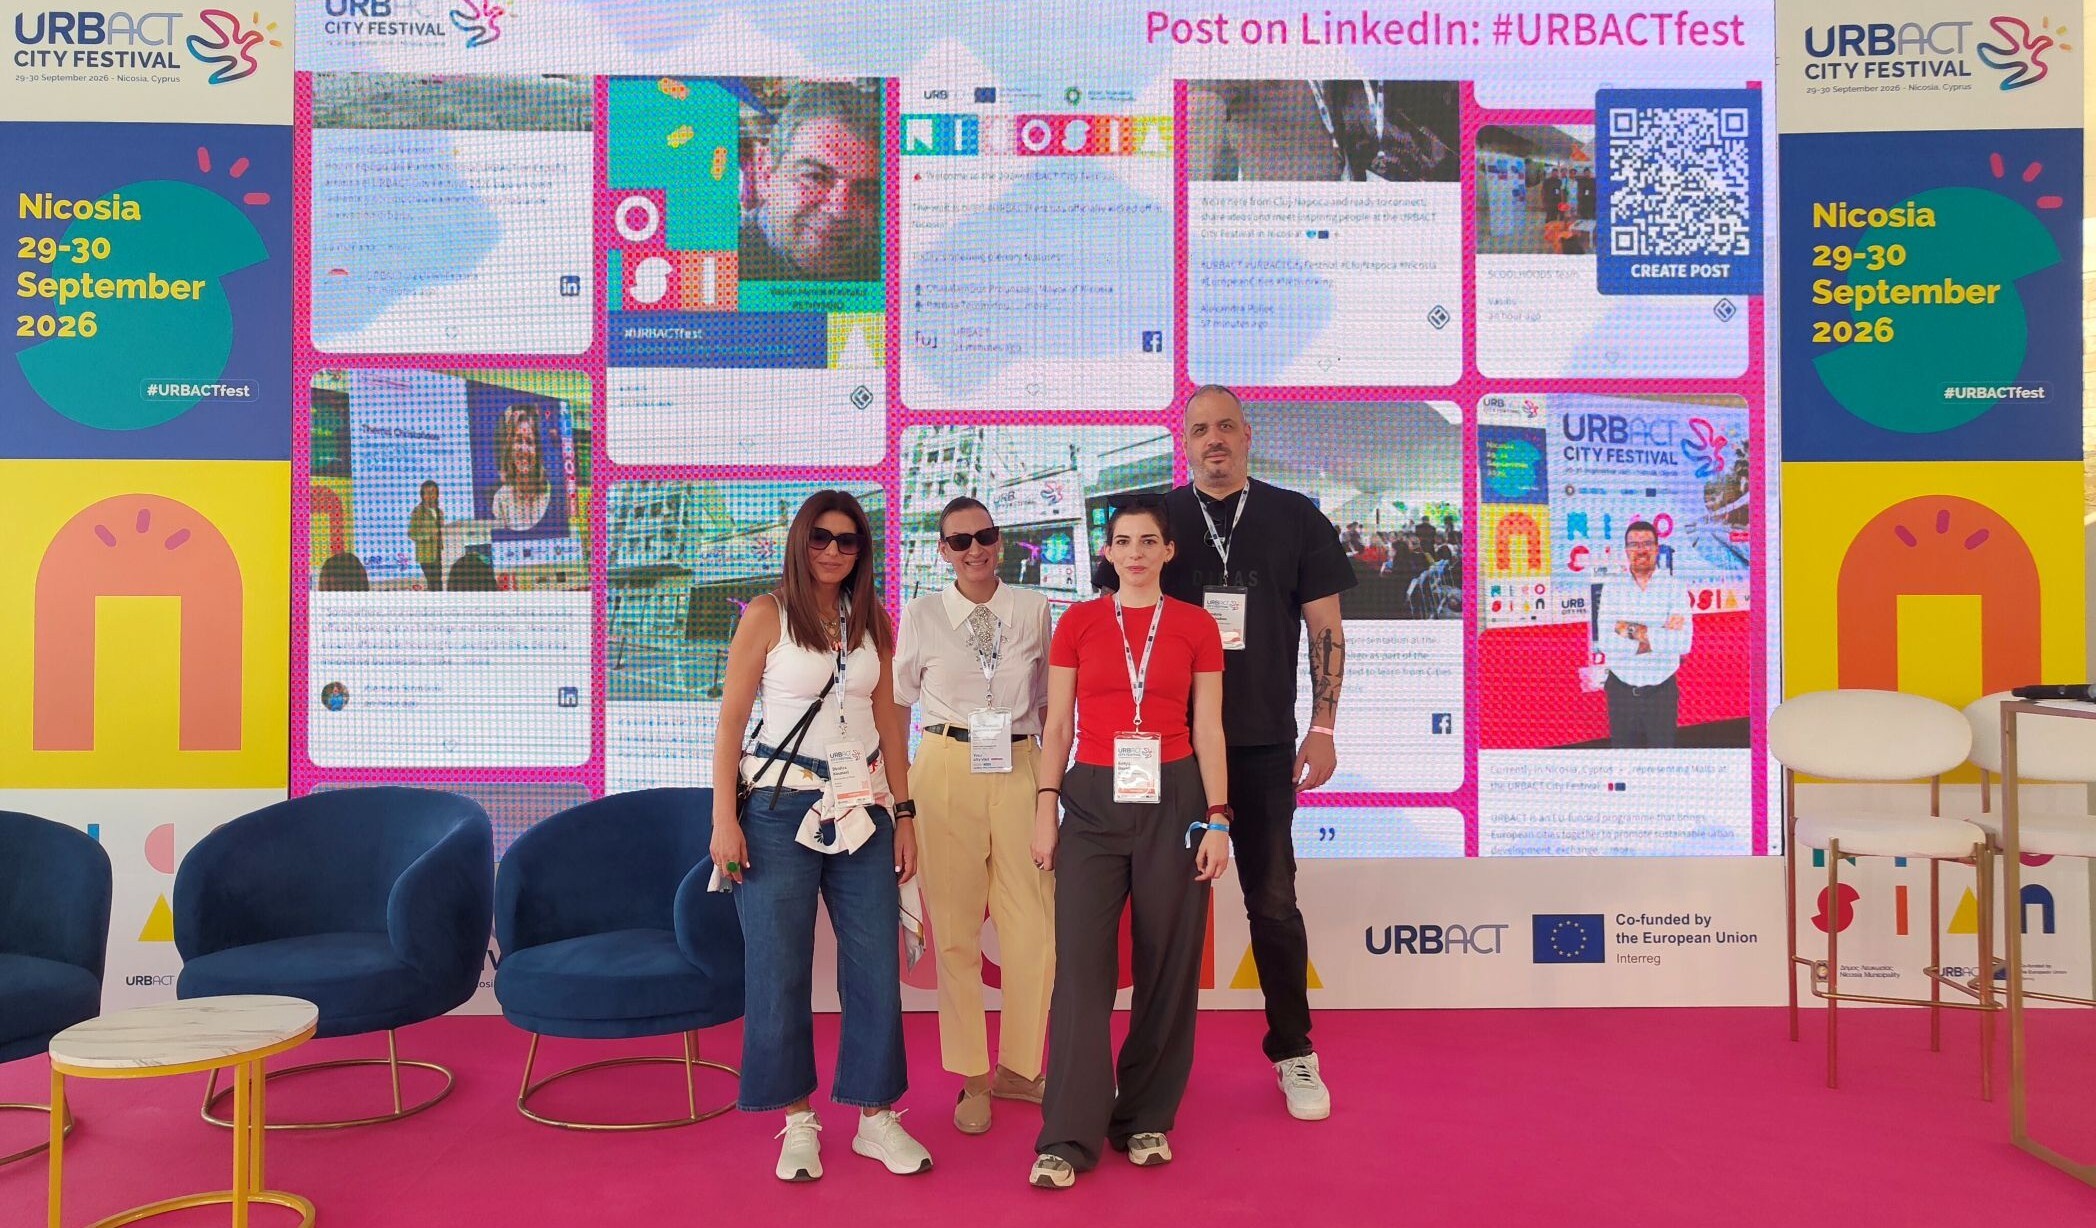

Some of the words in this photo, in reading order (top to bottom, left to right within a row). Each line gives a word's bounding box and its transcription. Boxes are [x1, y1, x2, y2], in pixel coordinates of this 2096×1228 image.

[15, 11, 184, 46] URBACT
[324, 22, 364, 35] CITY
[368, 22, 446, 36] FESTIVAL
[1147, 11, 1228, 46] Post
[1241, 19, 1288, 46] on
[1302, 11, 1481, 47] LinkedIn:
[1492, 11, 1746, 47] #URBACTfest
[1804, 21, 1973, 58] URBACT
[14, 50, 69, 68] CITY
[73, 50, 181, 69] FESTIVAL
[1804, 62, 1859, 80] CITY
[1864, 60, 1972, 79] FESTIVAL
[15, 74, 39, 83] 29-30
[41, 74, 87, 84] September
[151, 76, 181, 84] Cyprus
[1806, 86, 1831, 94] 29-30
[1832, 85, 1878, 94] September
[1880, 84, 1901, 92] 2026
[1942, 83, 1972, 92] Cyprus
[906, 118, 1167, 151] NIOSIA
[17, 192, 142, 221] Nicosia
[1812, 201, 1937, 228] Nicosia
[16, 236, 112, 264] 29-30
[1811, 244, 1907, 271] 29-30
[1631, 264, 1687, 278] CREATE
[1690, 263, 1731, 278] POST
[16, 272, 206, 304] September
[1811, 278, 2001, 312] September
[16, 311, 99, 338] 2026
[1811, 316, 1895, 343] 2026
[146, 383, 250, 399] #URBACTfest
[1943, 386, 2046, 400] #URBACTfest
[1562, 412, 1680, 447] URBACT
[1563, 446, 1606, 462] CITY
[1607, 448, 1679, 466] FESTIVAL
[1561, 598, 1585, 609] URB
[1615, 913, 1691, 927] Co-funded
[1694, 913, 1712, 929] by
[1365, 923, 1510, 956] URBACT
[1615, 932, 1640, 944] the
[1642, 932, 1713, 947] European
[1715, 931, 1759, 944] Union
[1615, 953, 1662, 966] Interreg
[125, 975, 175, 987] URBACT
